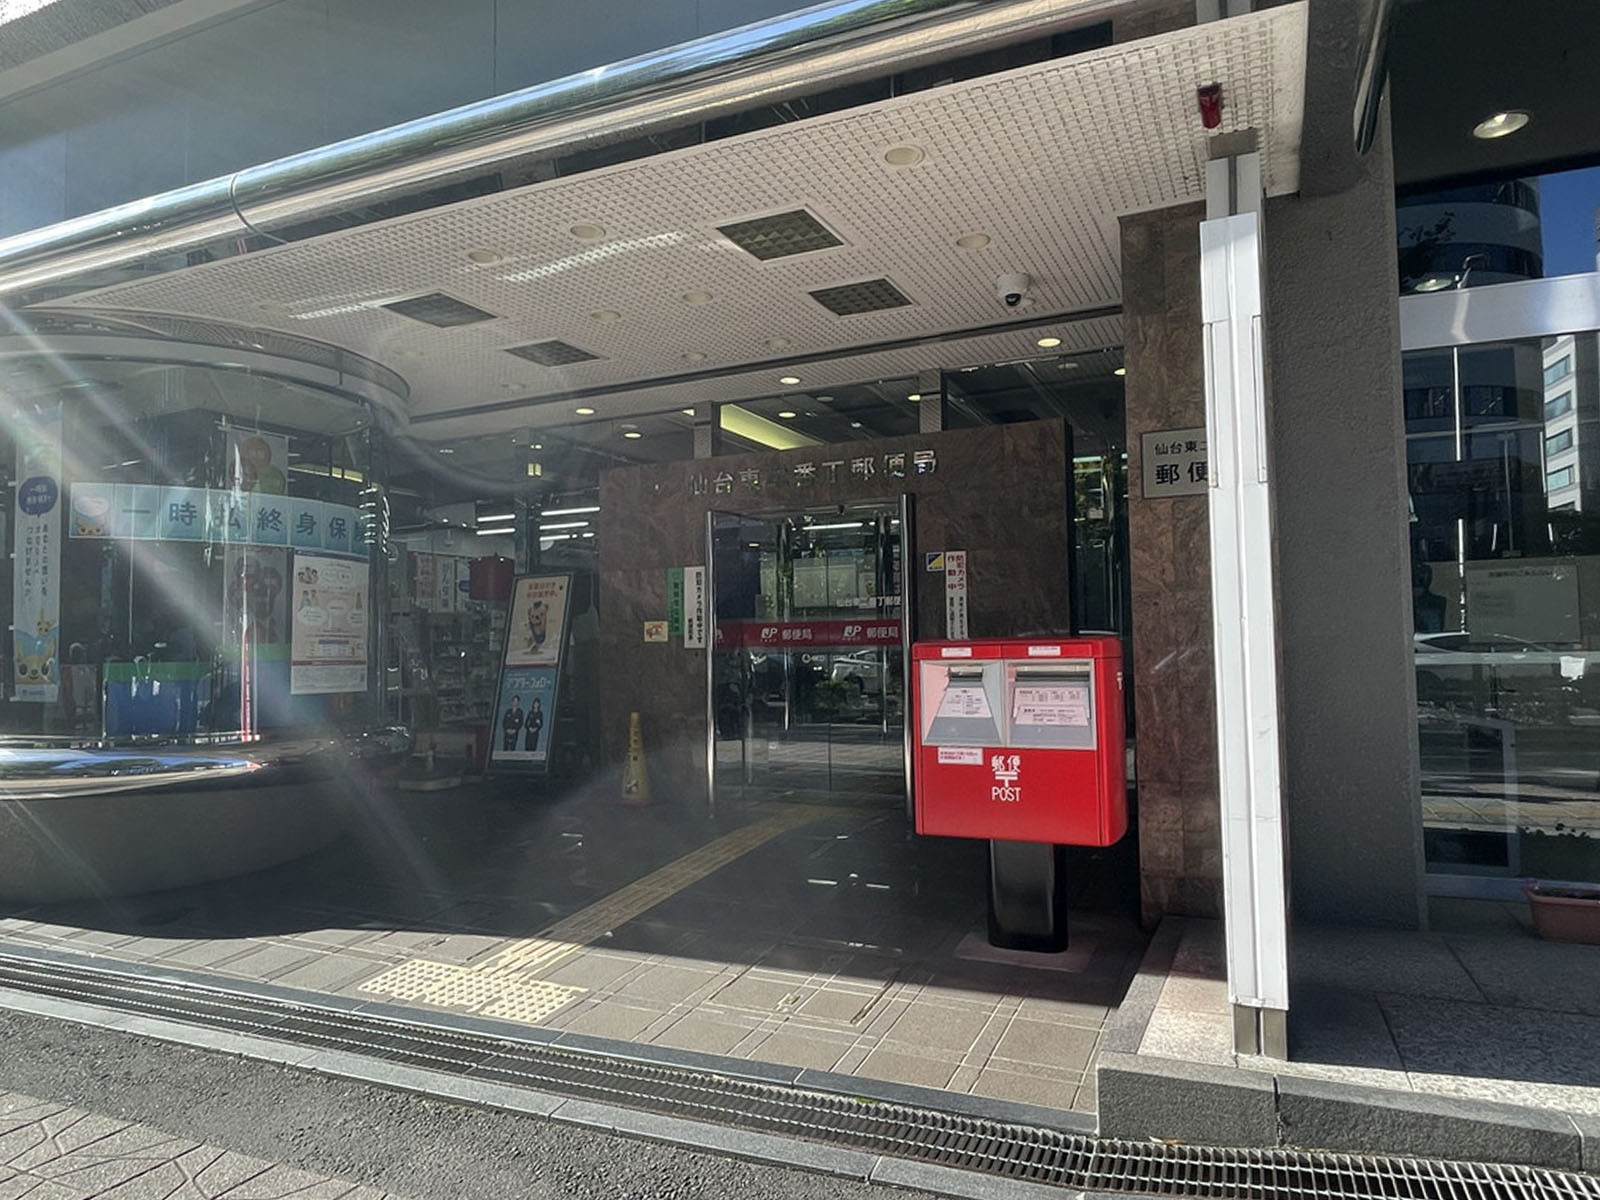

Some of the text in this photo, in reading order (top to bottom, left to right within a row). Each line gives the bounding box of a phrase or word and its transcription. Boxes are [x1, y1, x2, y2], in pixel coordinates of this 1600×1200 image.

[689, 448, 937, 495] 仙台東番丁郵便局
[991, 755, 1021, 772] 郵便
[991, 787, 1022, 802] POST
